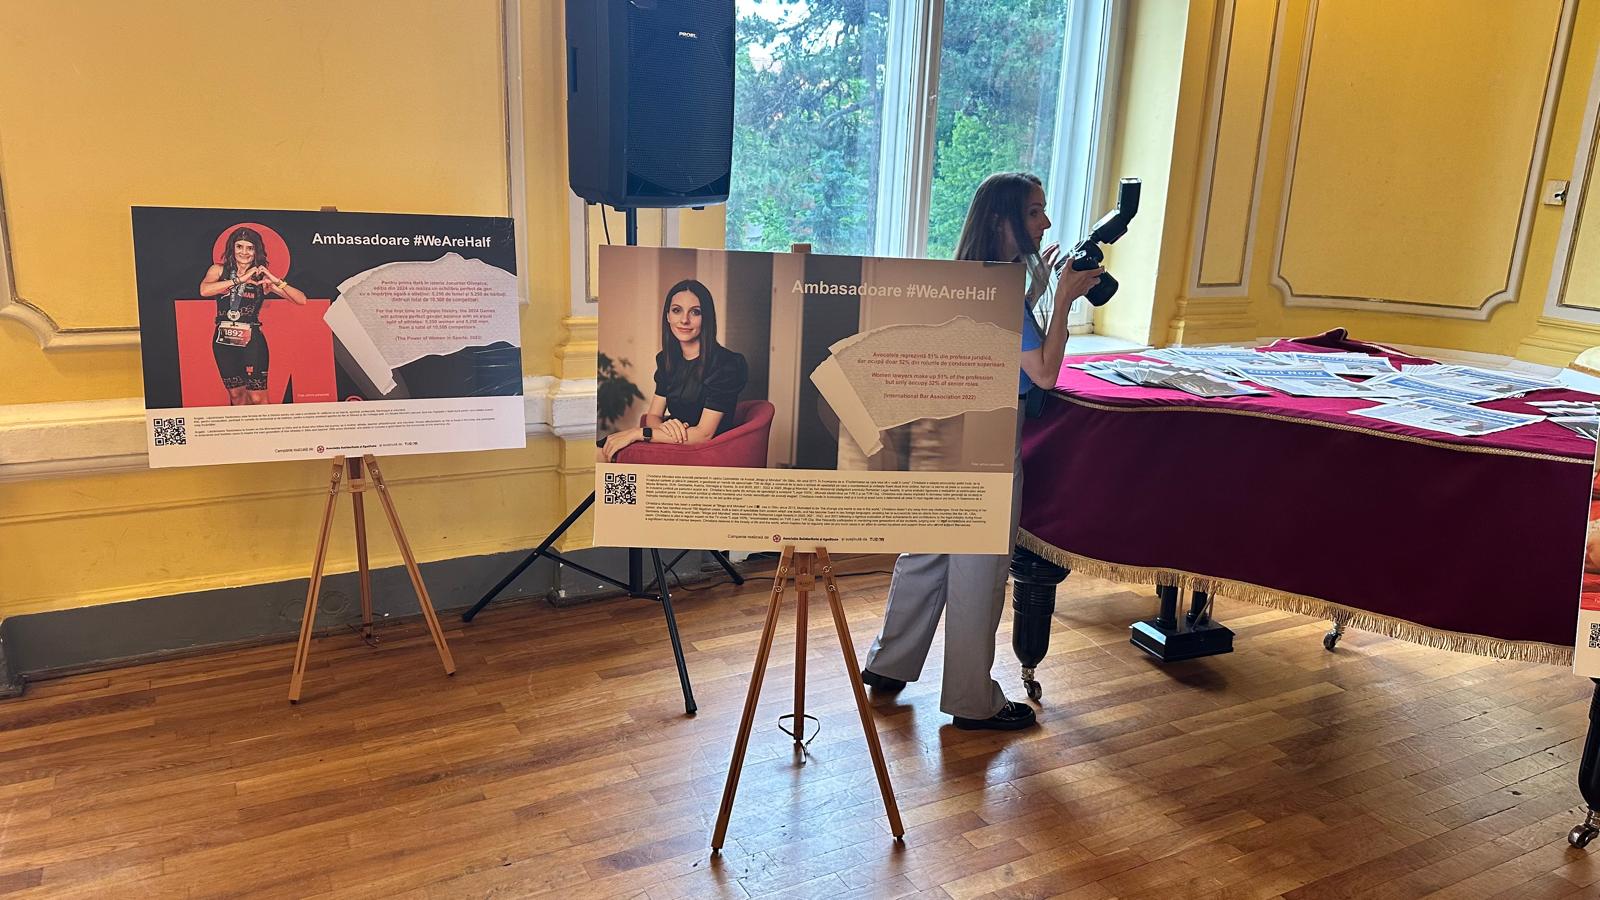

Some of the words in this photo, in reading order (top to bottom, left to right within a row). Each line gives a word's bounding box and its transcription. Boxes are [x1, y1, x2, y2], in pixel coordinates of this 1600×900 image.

[312, 232, 410, 246] Ambasadoare
[413, 235, 491, 248] #WeAreHalf
[792, 280, 902, 298] Ambasadoare
[906, 284, 996, 301] #WeAreHalf
[224, 329, 244, 337] 1892
